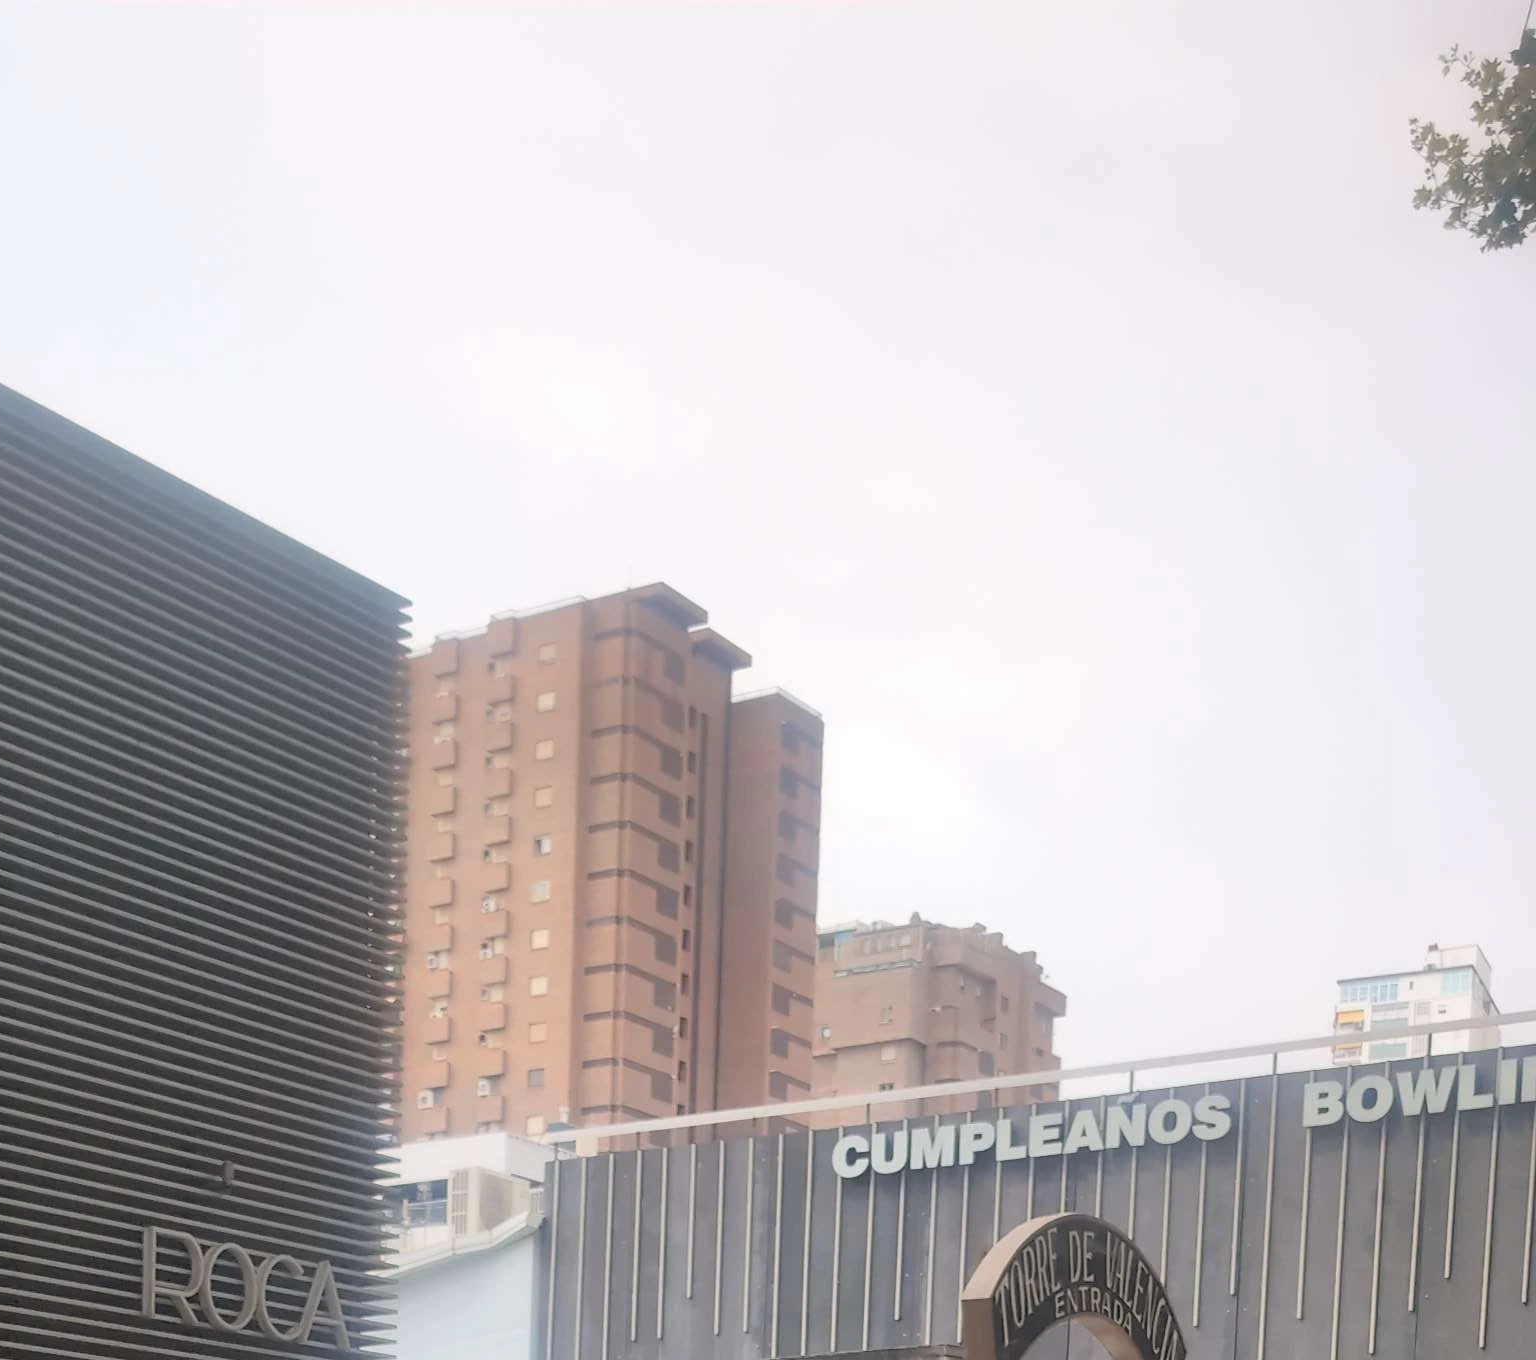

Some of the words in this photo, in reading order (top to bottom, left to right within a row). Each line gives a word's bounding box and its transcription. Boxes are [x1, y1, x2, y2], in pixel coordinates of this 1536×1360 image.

[142, 1226, 351, 1350] ROCA
[995, 1227, 1062, 1348] TORRE
[1068, 1230, 1096, 1283] DE
[1054, 1286, 1132, 1337] ENTRADA
